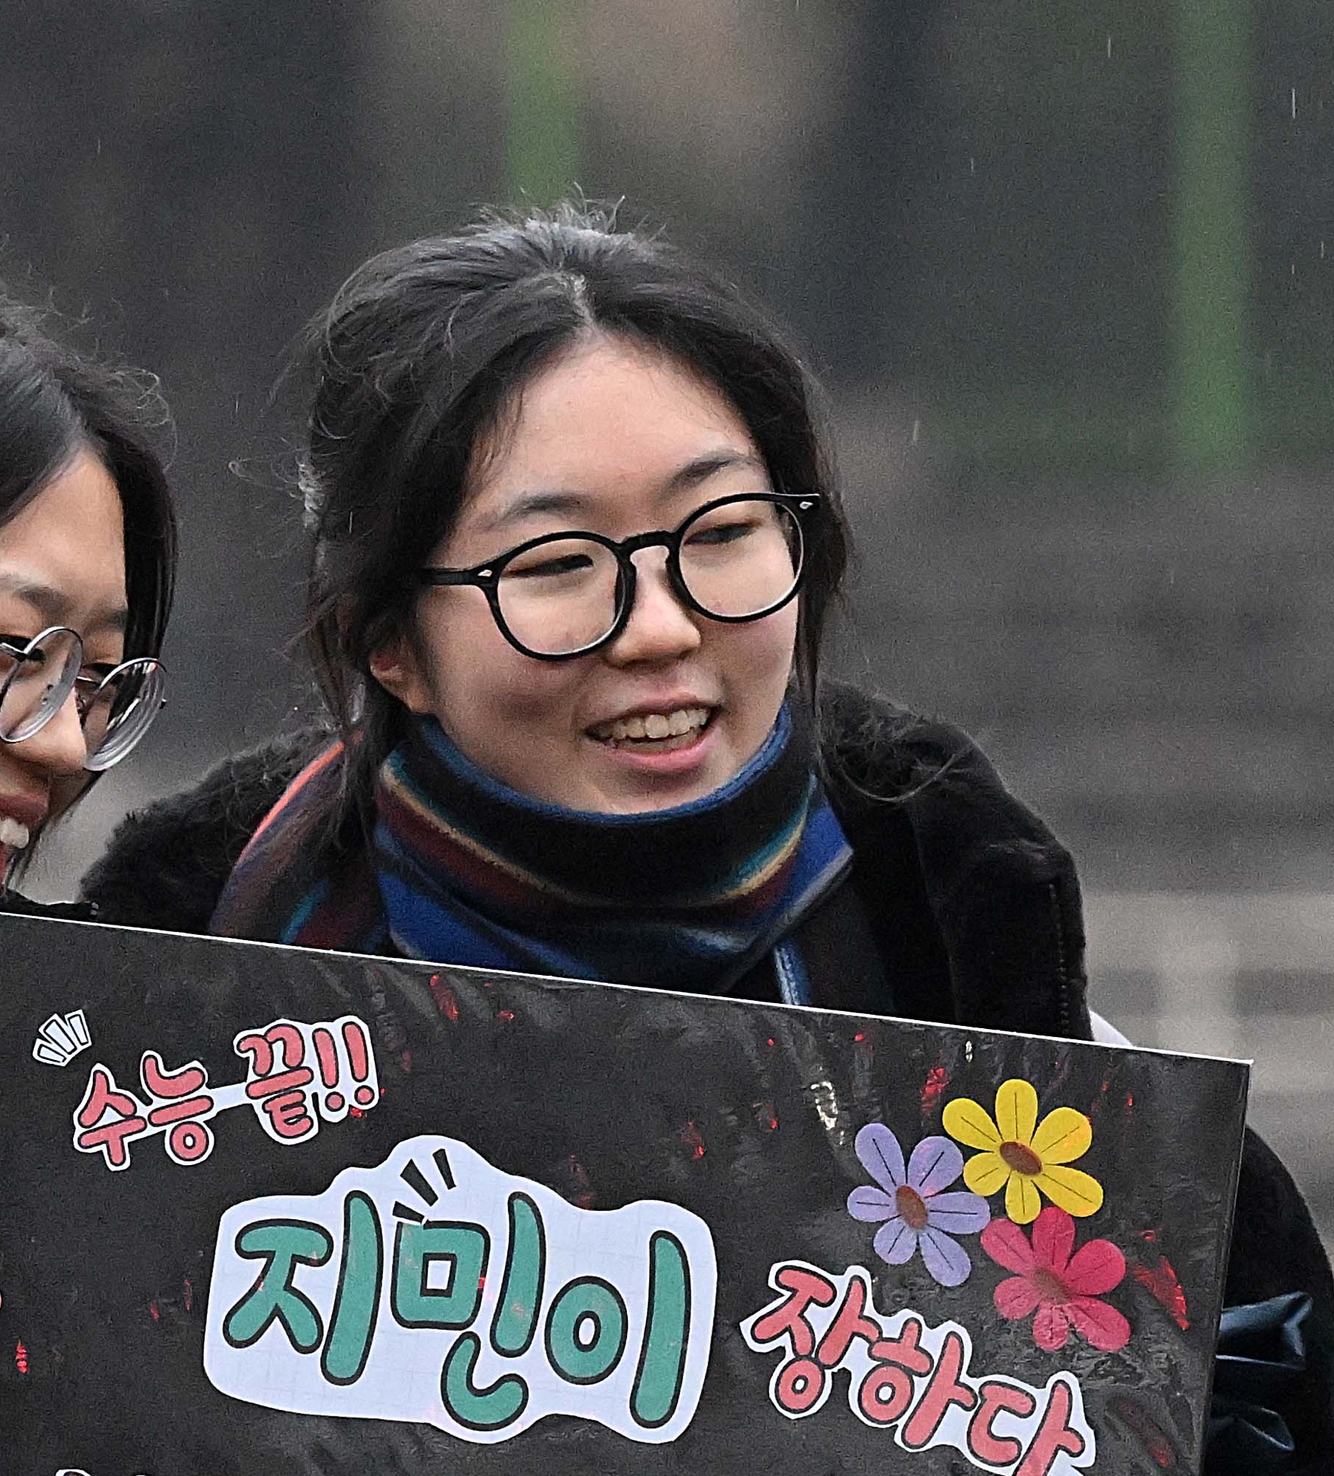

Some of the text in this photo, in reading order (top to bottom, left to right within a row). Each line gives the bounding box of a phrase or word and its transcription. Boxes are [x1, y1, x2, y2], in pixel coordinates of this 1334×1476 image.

[77, 1016, 379, 1168] 수능 끝!!
[223, 1190, 692, 1429] 지민이
